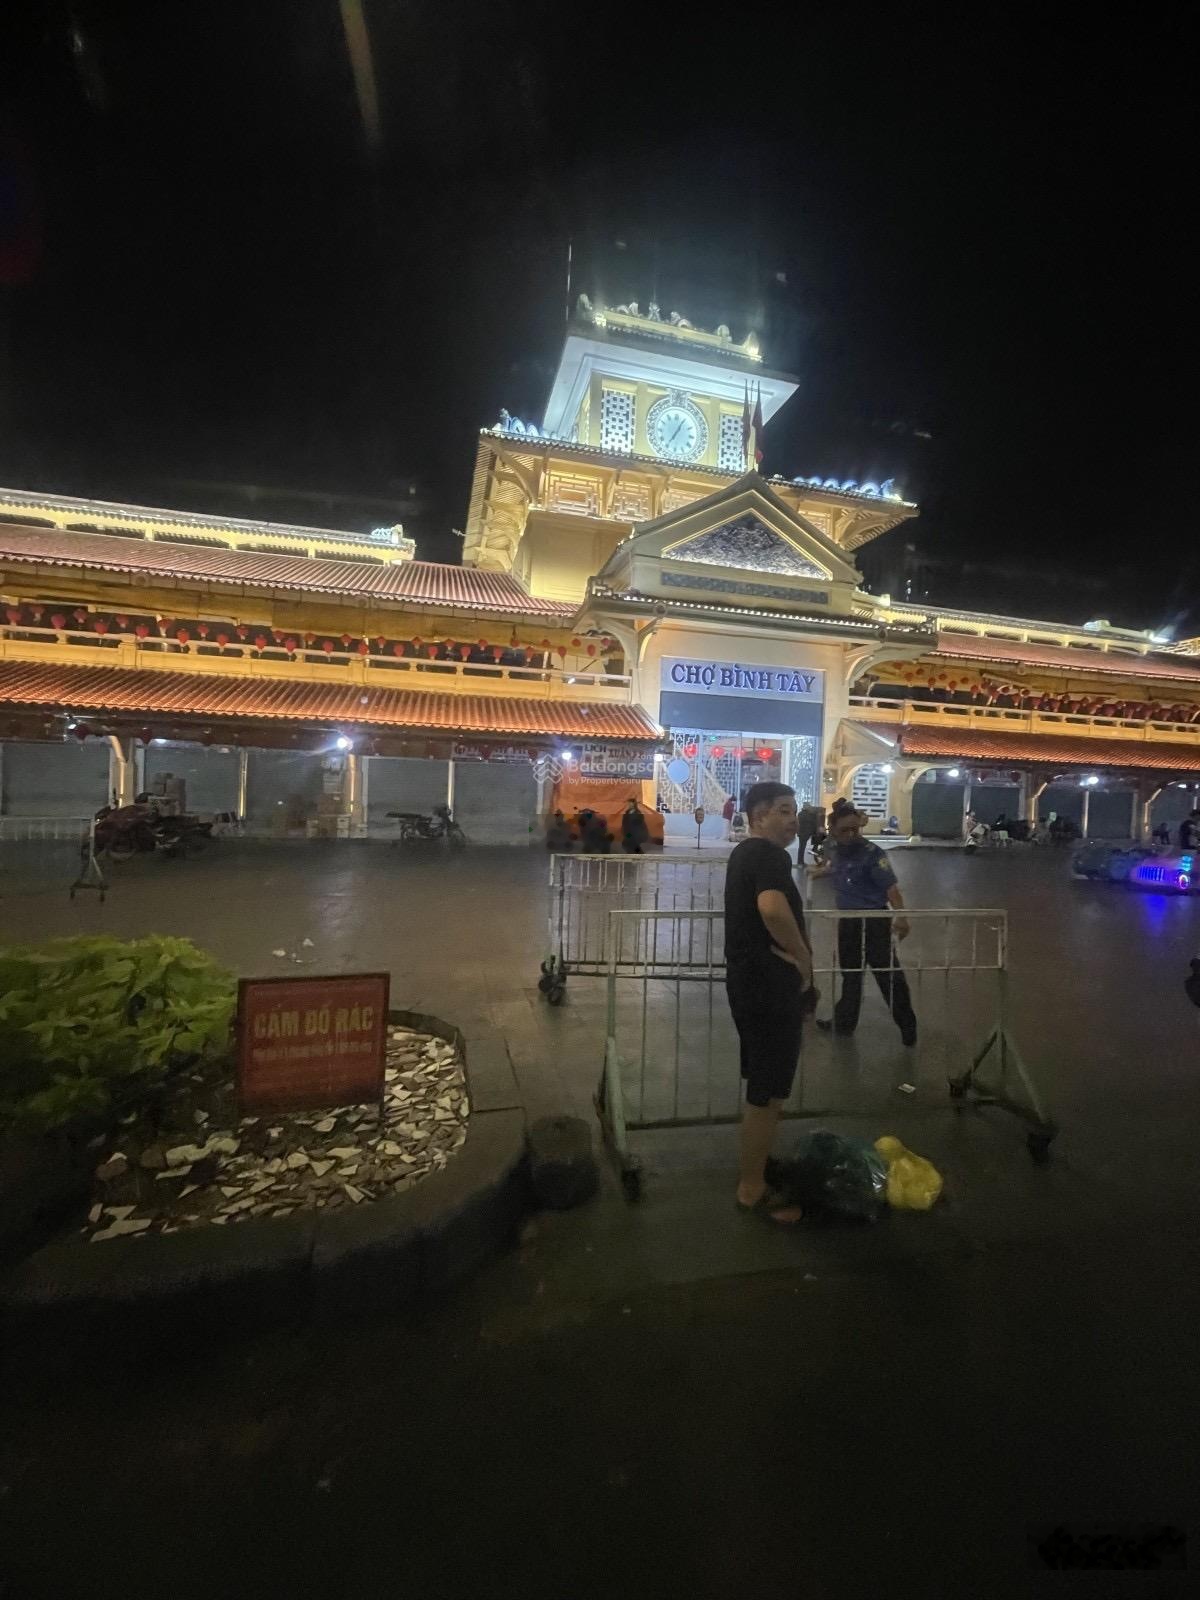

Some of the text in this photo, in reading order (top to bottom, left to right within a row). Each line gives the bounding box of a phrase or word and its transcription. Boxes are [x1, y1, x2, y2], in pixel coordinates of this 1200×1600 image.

[671, 663, 816, 693] CHỢ BÌNH TÂY
